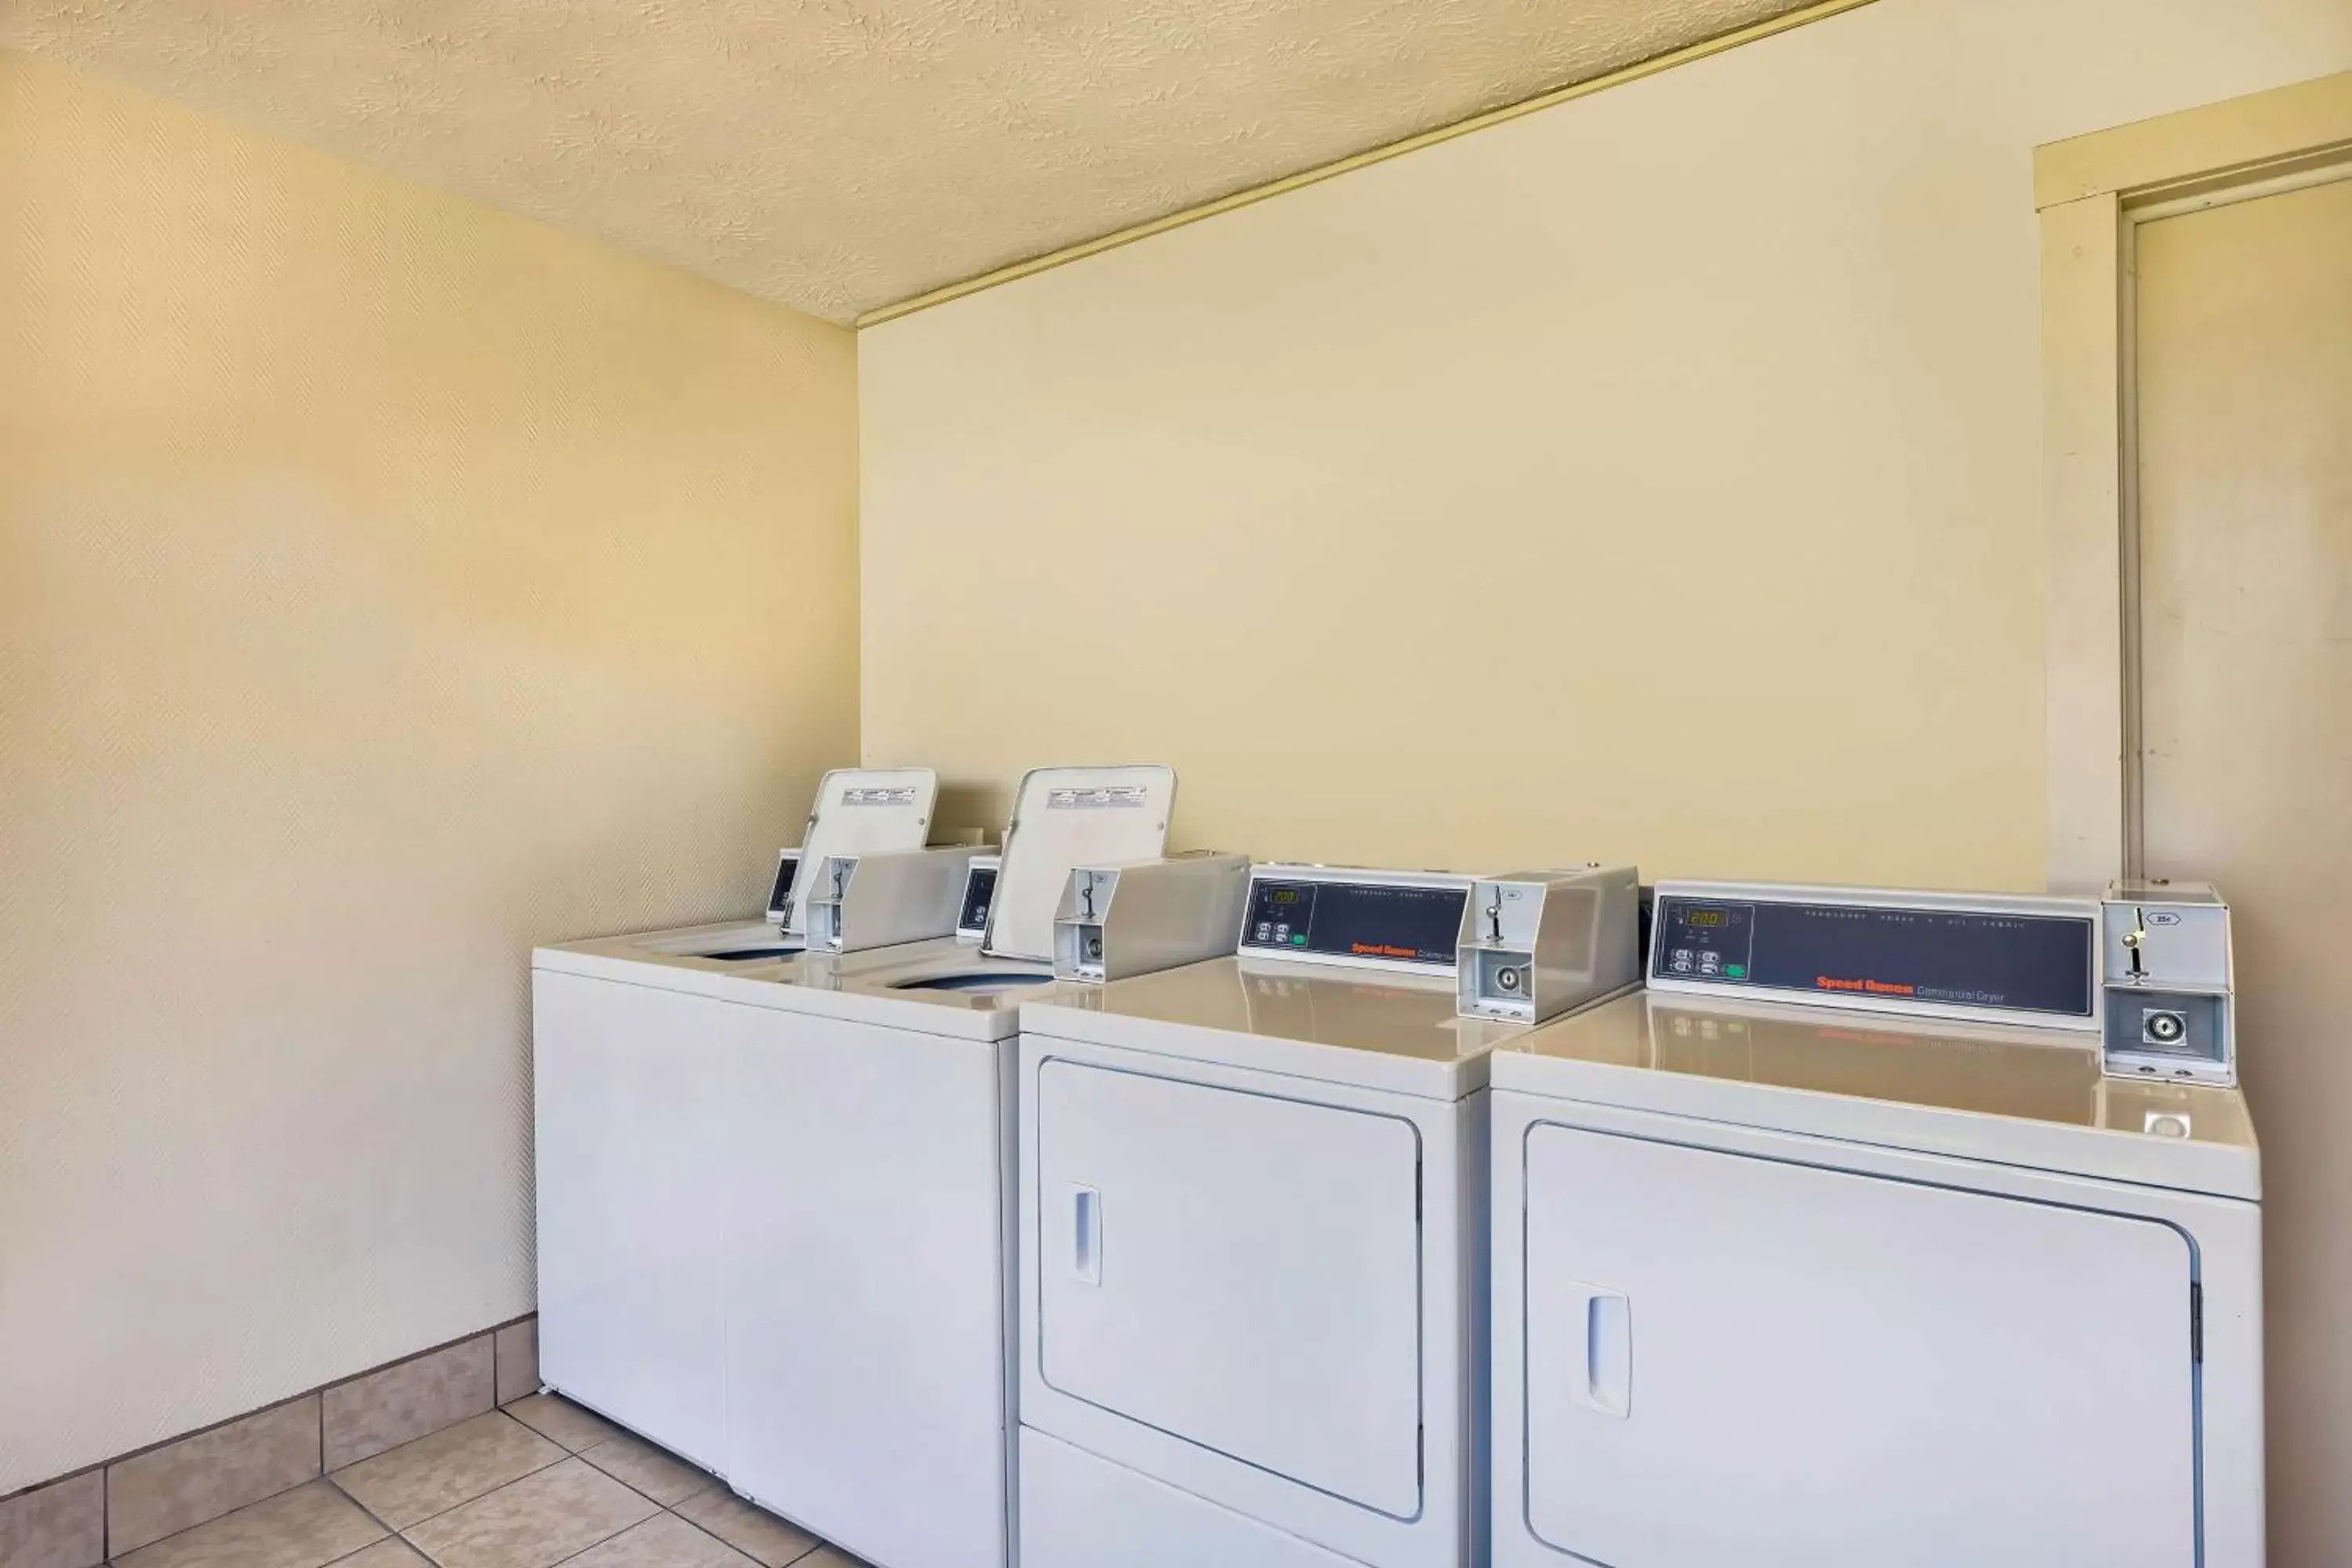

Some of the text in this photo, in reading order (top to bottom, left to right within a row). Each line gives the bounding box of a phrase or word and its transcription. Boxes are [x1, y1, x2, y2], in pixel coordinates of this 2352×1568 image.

[1351, 942, 1383, 953] Speed
[1817, 976, 1864, 989] Speed
[1865, 979, 1914, 994] Queen
[1976, 990, 2005, 1004] Dryer
